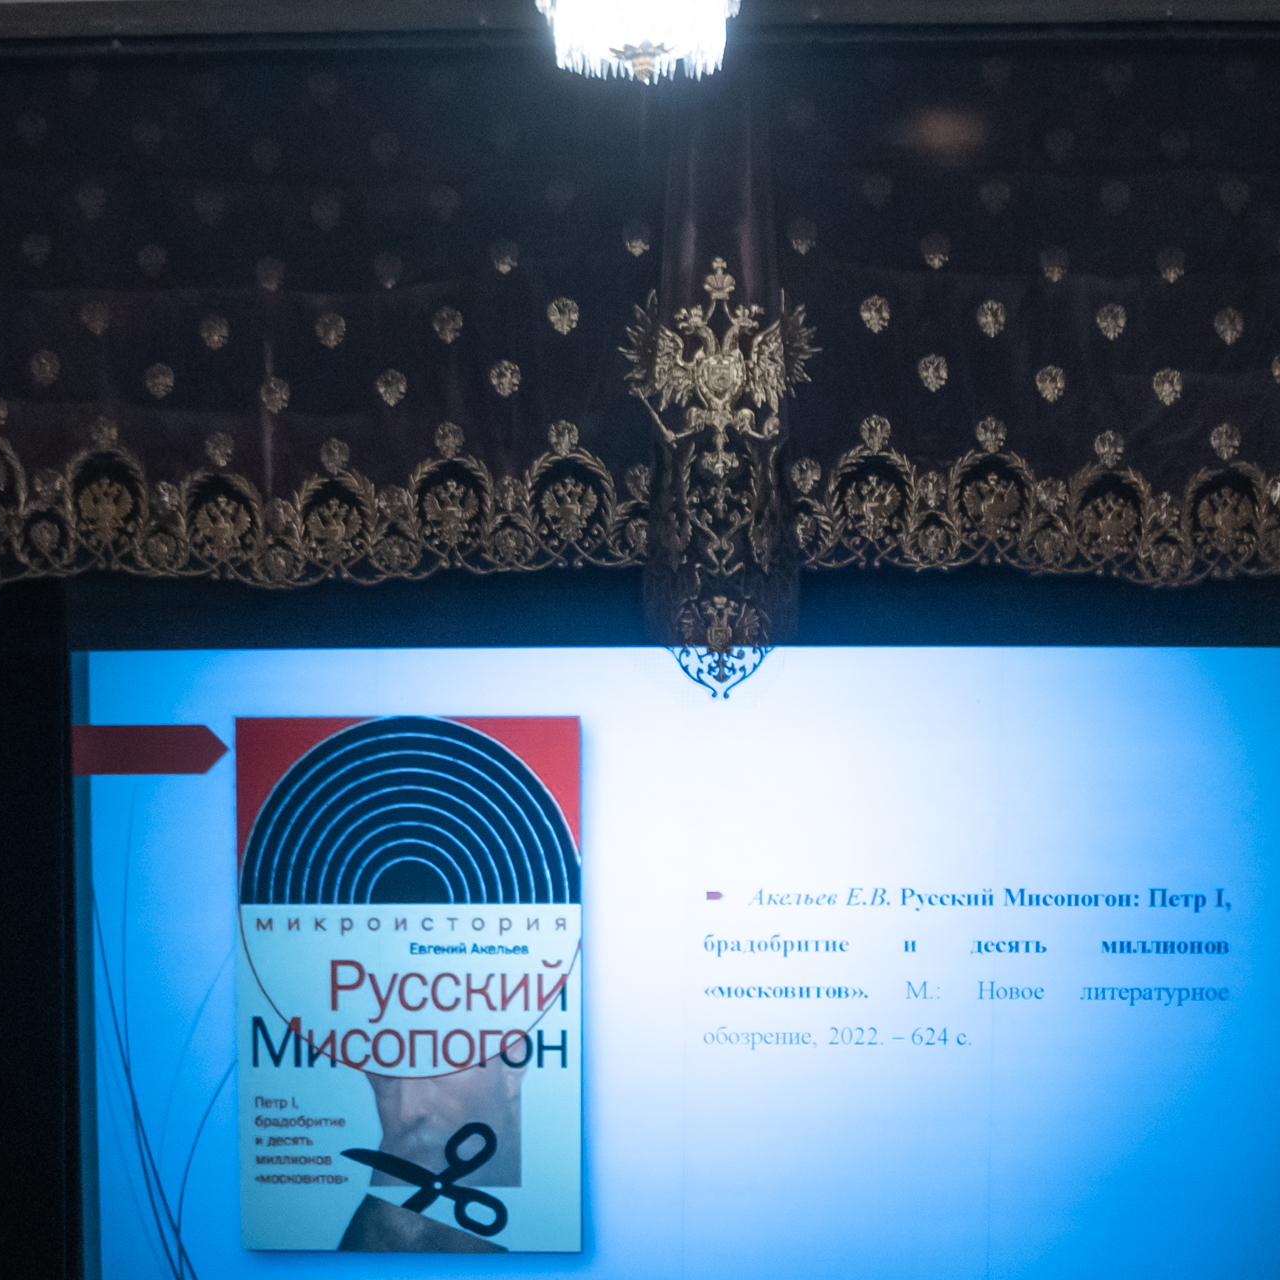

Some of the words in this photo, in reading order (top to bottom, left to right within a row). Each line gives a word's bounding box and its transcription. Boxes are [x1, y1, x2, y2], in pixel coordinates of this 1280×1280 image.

[749, 888, 837, 907] Акельев
[846, 888, 891, 907] Е.В.
[901, 887, 994, 911] Русский
[1004, 888, 1140, 908] Мисопогон:
[1148, 888, 1207, 913] Петр
[256, 915, 567, 936] микроистория
[409, 942, 467, 955] Евгений
[470, 942, 529, 955] Акельев
[704, 934, 849, 958] брадобритие
[904, 940, 917, 953] и
[970, 939, 1047, 955] десять
[1101, 940, 1230, 955] миллионов
[329, 959, 568, 1024] Русский
[704, 985, 869, 1000] «московитов».
[905, 980, 941, 1000] М.:
[977, 981, 1045, 1000] Новое
[1080, 985, 1230, 1007] литературное
[252, 1016, 568, 1069] Мисопогон
[703, 1026, 818, 1051] обозрение,
[828, 1026, 884, 1046] 2022.
[911, 1027, 949, 1046] 624
[956, 1032, 972, 1046] с.
[254, 1096, 287, 1110] Петр
[254, 1115, 346, 1129] брадобритие
[267, 1136, 314, 1148] десять
[255, 1155, 332, 1166] миллионов
